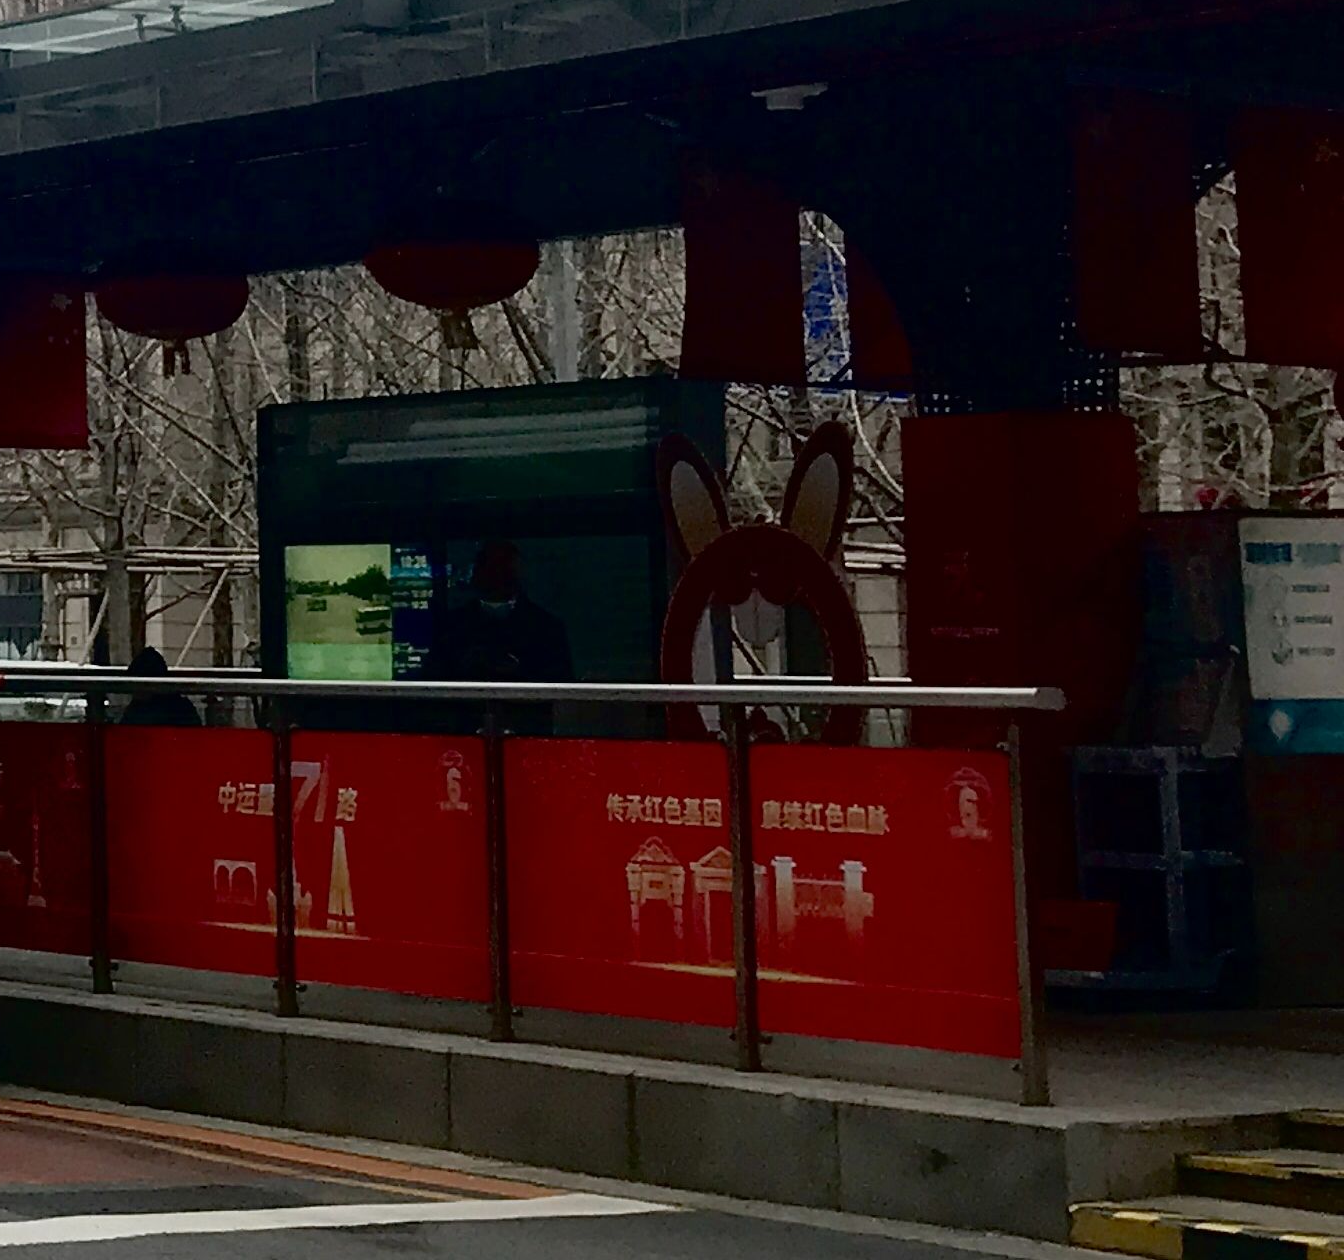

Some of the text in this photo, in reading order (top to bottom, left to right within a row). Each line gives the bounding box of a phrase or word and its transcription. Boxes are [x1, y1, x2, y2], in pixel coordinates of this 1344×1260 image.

[606, 793, 723, 829] 传承红色基因
